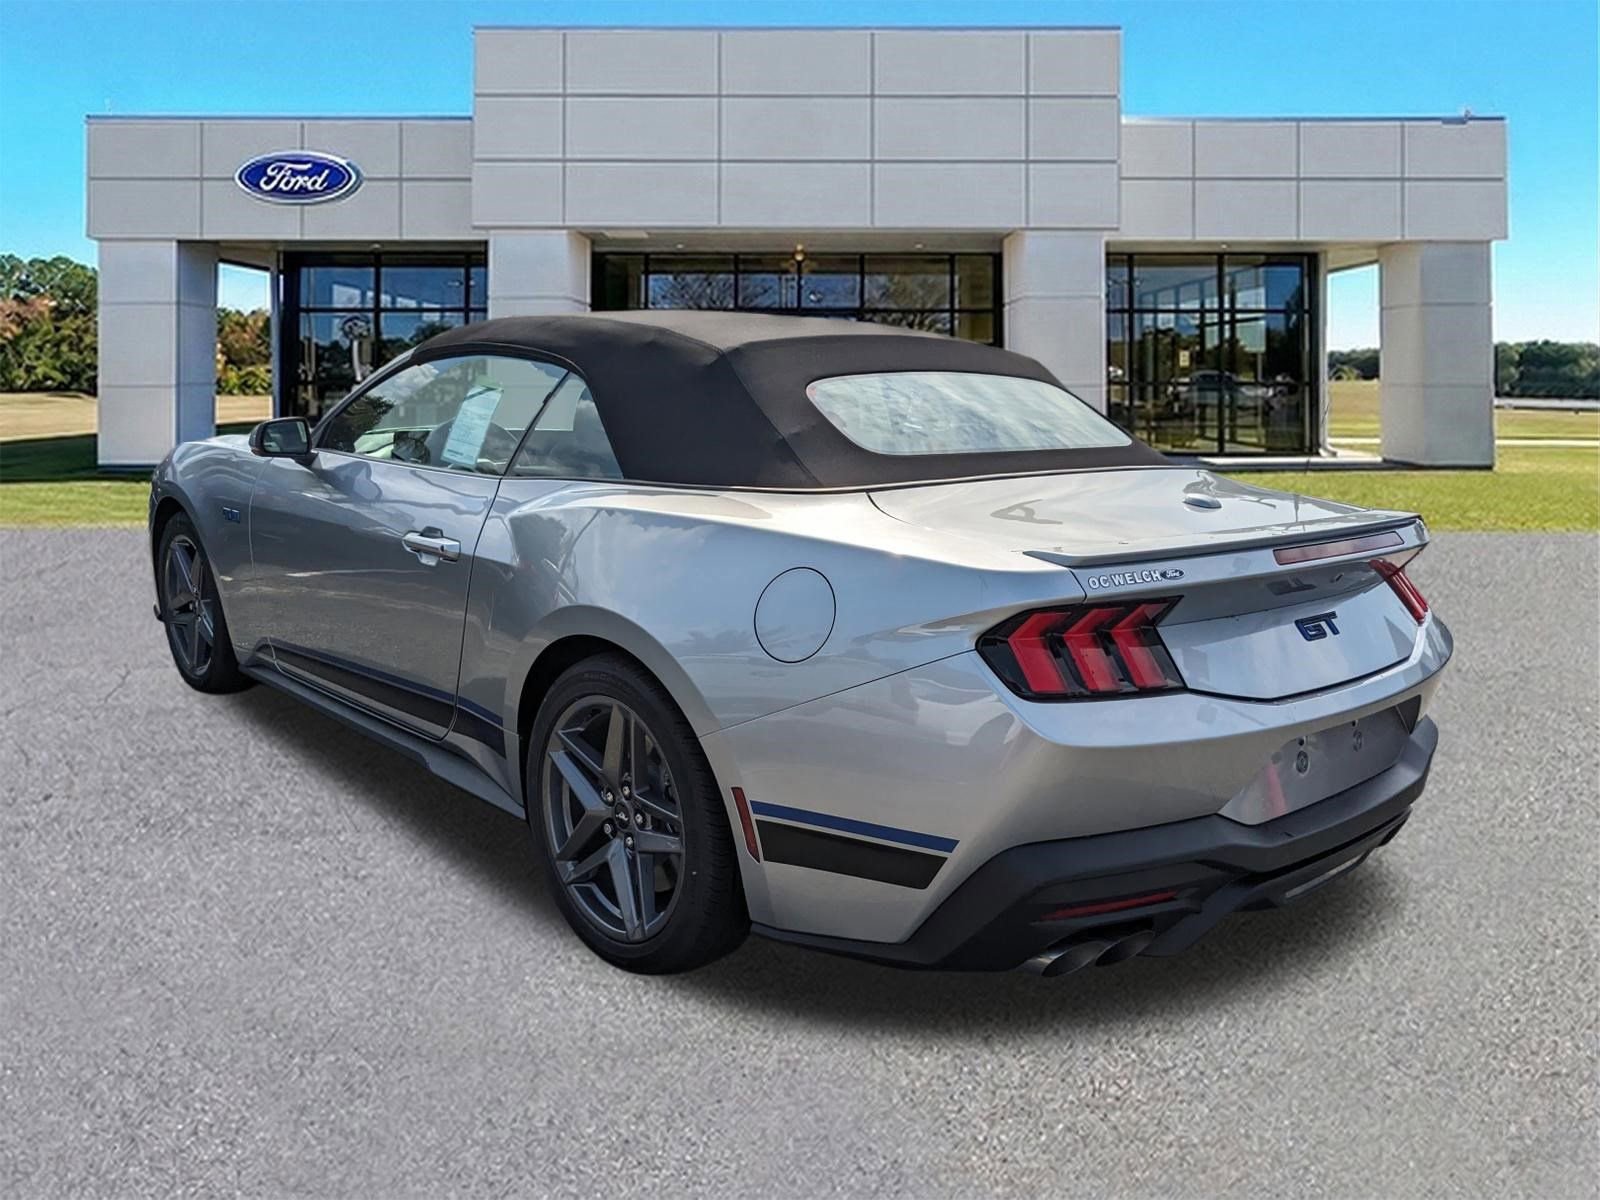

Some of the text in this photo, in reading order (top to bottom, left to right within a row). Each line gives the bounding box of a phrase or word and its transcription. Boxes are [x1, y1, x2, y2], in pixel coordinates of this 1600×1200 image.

[259, 161, 330, 191] Ford
[1088, 575, 1110, 589] OC
[1110, 569, 1162, 586] WELCH
[1294, 610, 1340, 642] GT
